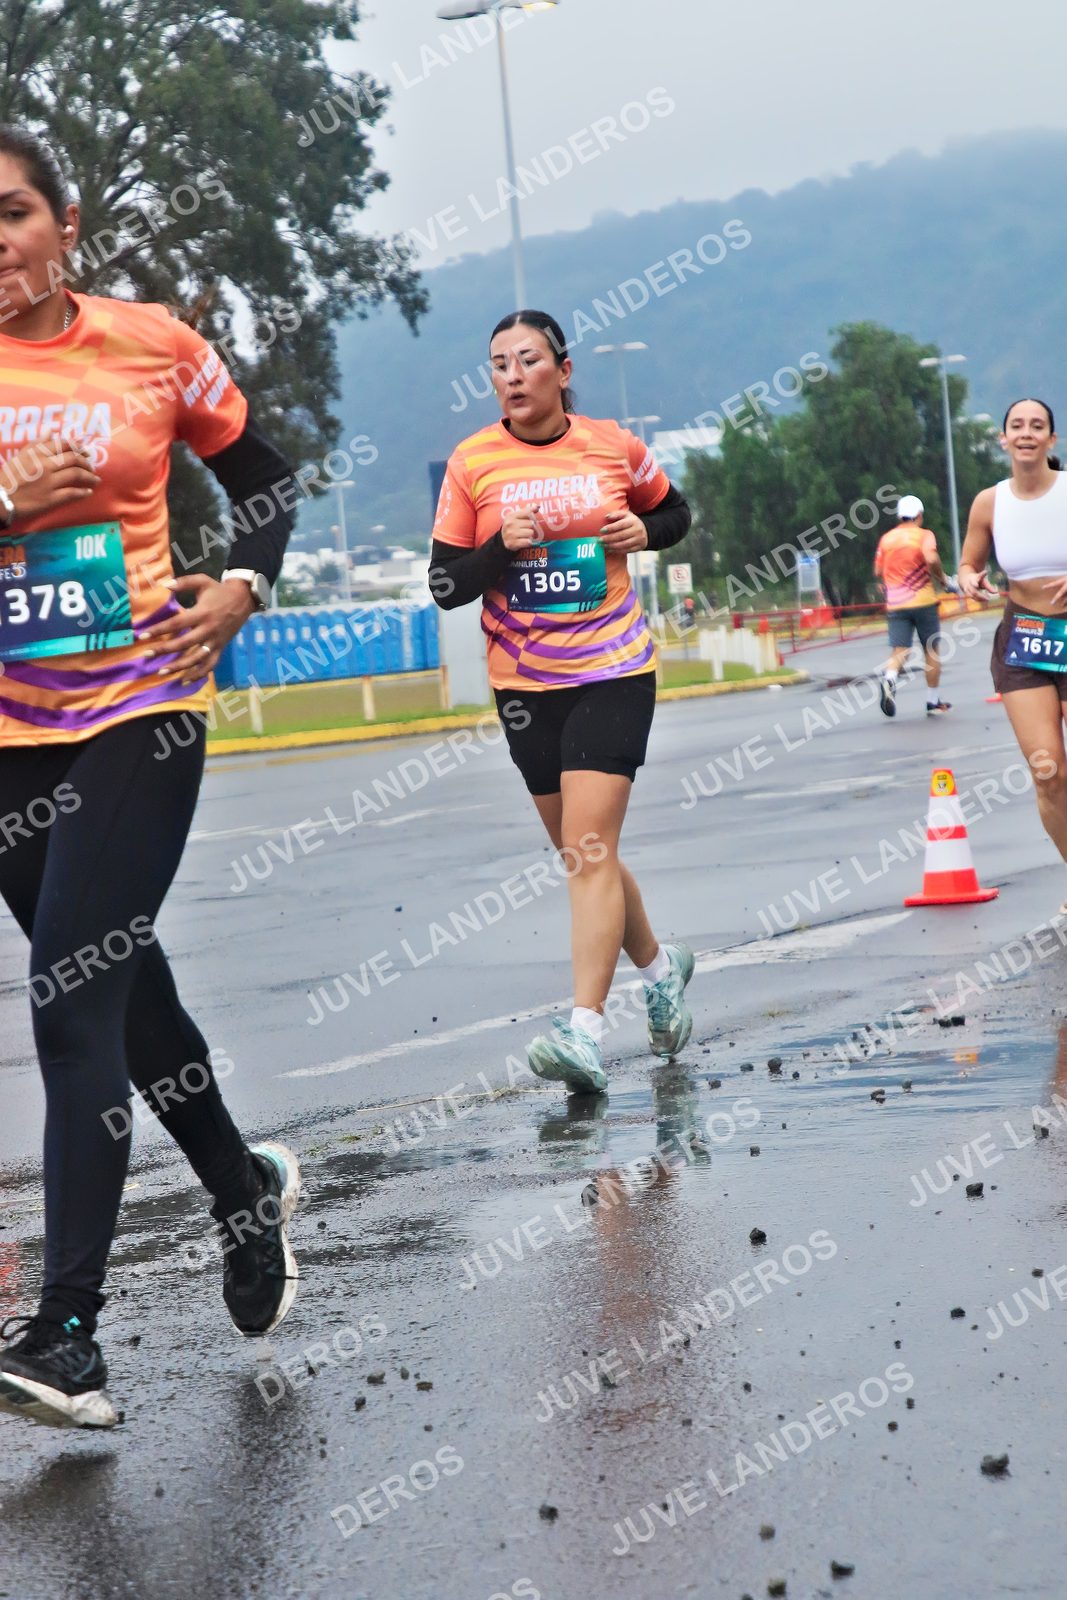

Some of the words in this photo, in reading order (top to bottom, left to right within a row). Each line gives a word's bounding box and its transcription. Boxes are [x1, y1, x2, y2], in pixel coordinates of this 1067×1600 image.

[501, 473, 597, 504] CARRERA
[75, 533, 107, 560] 10K
[577, 543, 595, 559] 10K
[519, 570, 581, 593] 1305
[0, 580, 87, 625] 378
[1021, 636, 1065, 656] 1617
